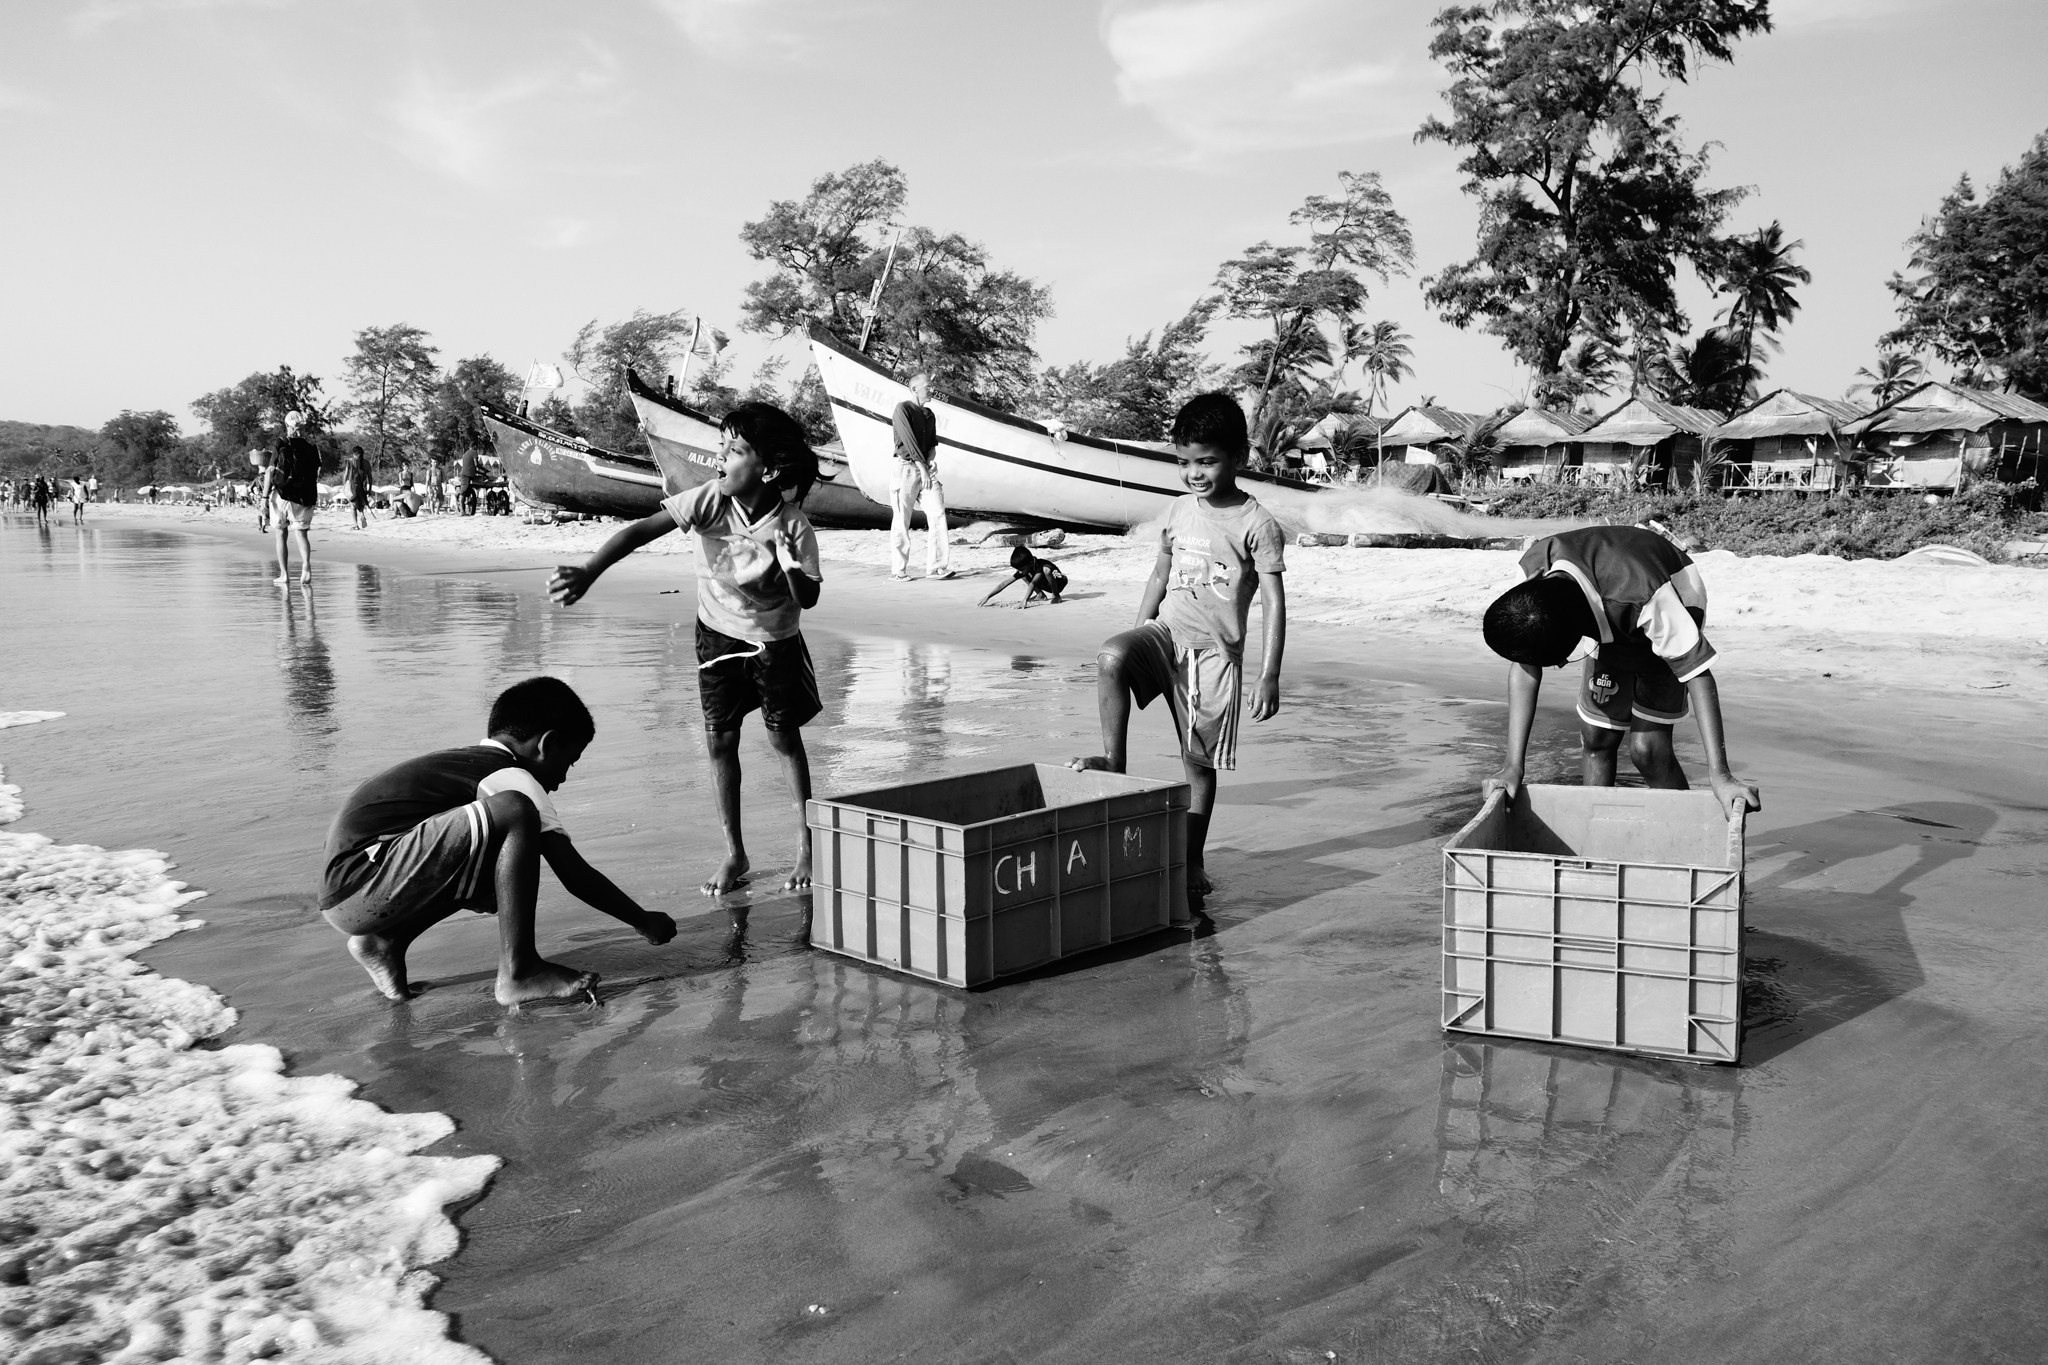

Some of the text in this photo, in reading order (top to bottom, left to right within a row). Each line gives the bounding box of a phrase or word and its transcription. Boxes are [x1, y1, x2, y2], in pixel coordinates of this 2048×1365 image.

[933, 390, 950, 403] 2596
[1176, 534, 1211, 548] WARRIOR
[1596, 678, 1611, 687] GOA
